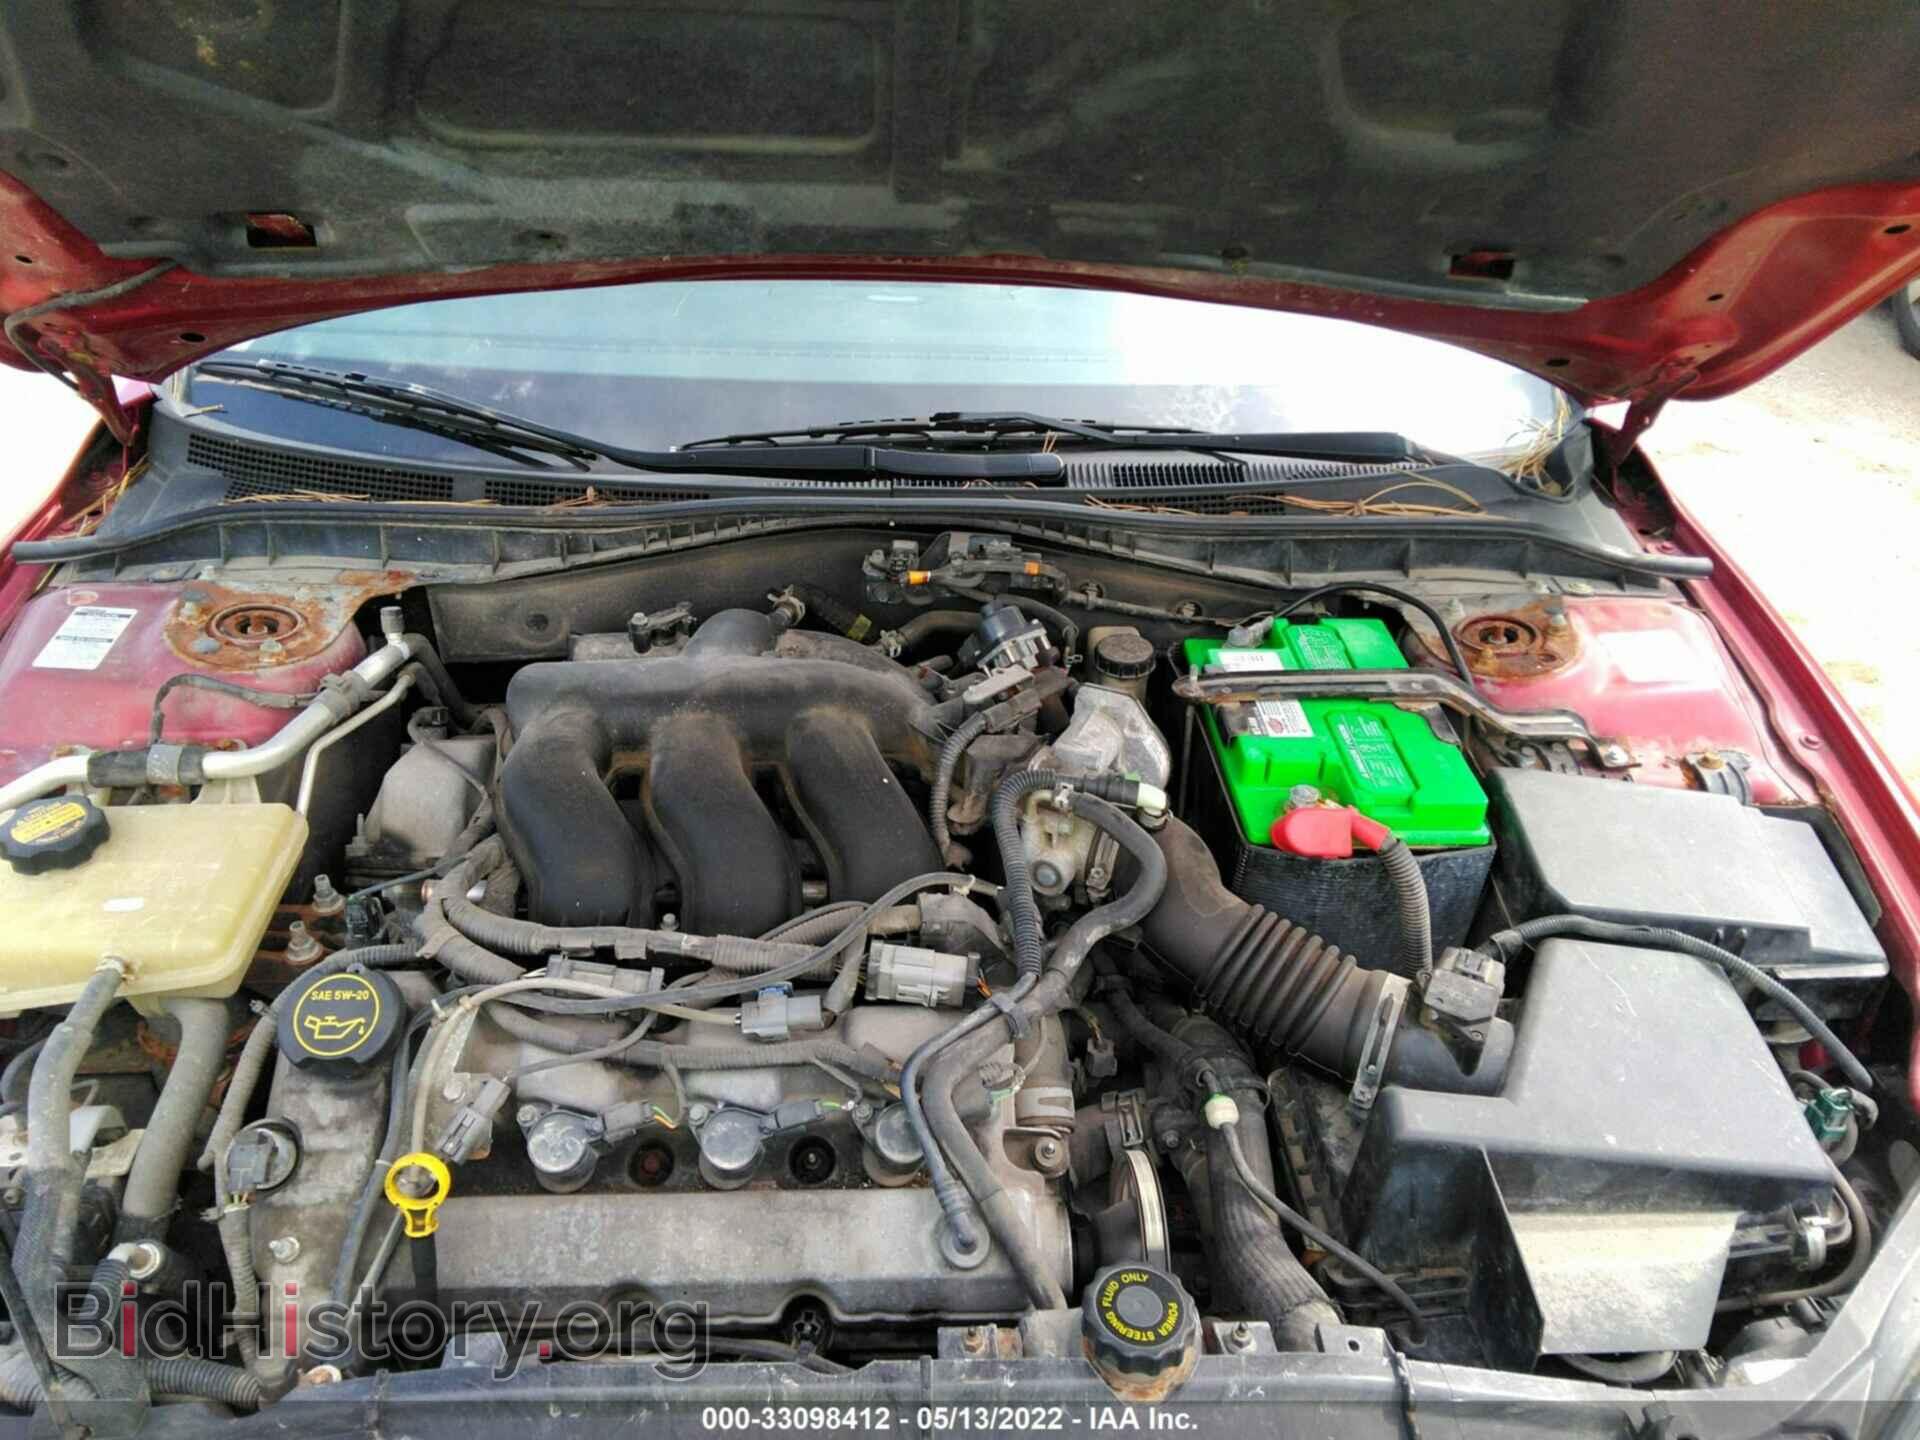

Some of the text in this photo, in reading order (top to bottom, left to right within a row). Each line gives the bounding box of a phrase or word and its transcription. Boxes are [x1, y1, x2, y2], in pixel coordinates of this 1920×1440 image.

[311, 989, 370, 1001] SAE 5W-20
[1101, 1271, 1180, 1342] POWER STEERING FLUID ONLY
